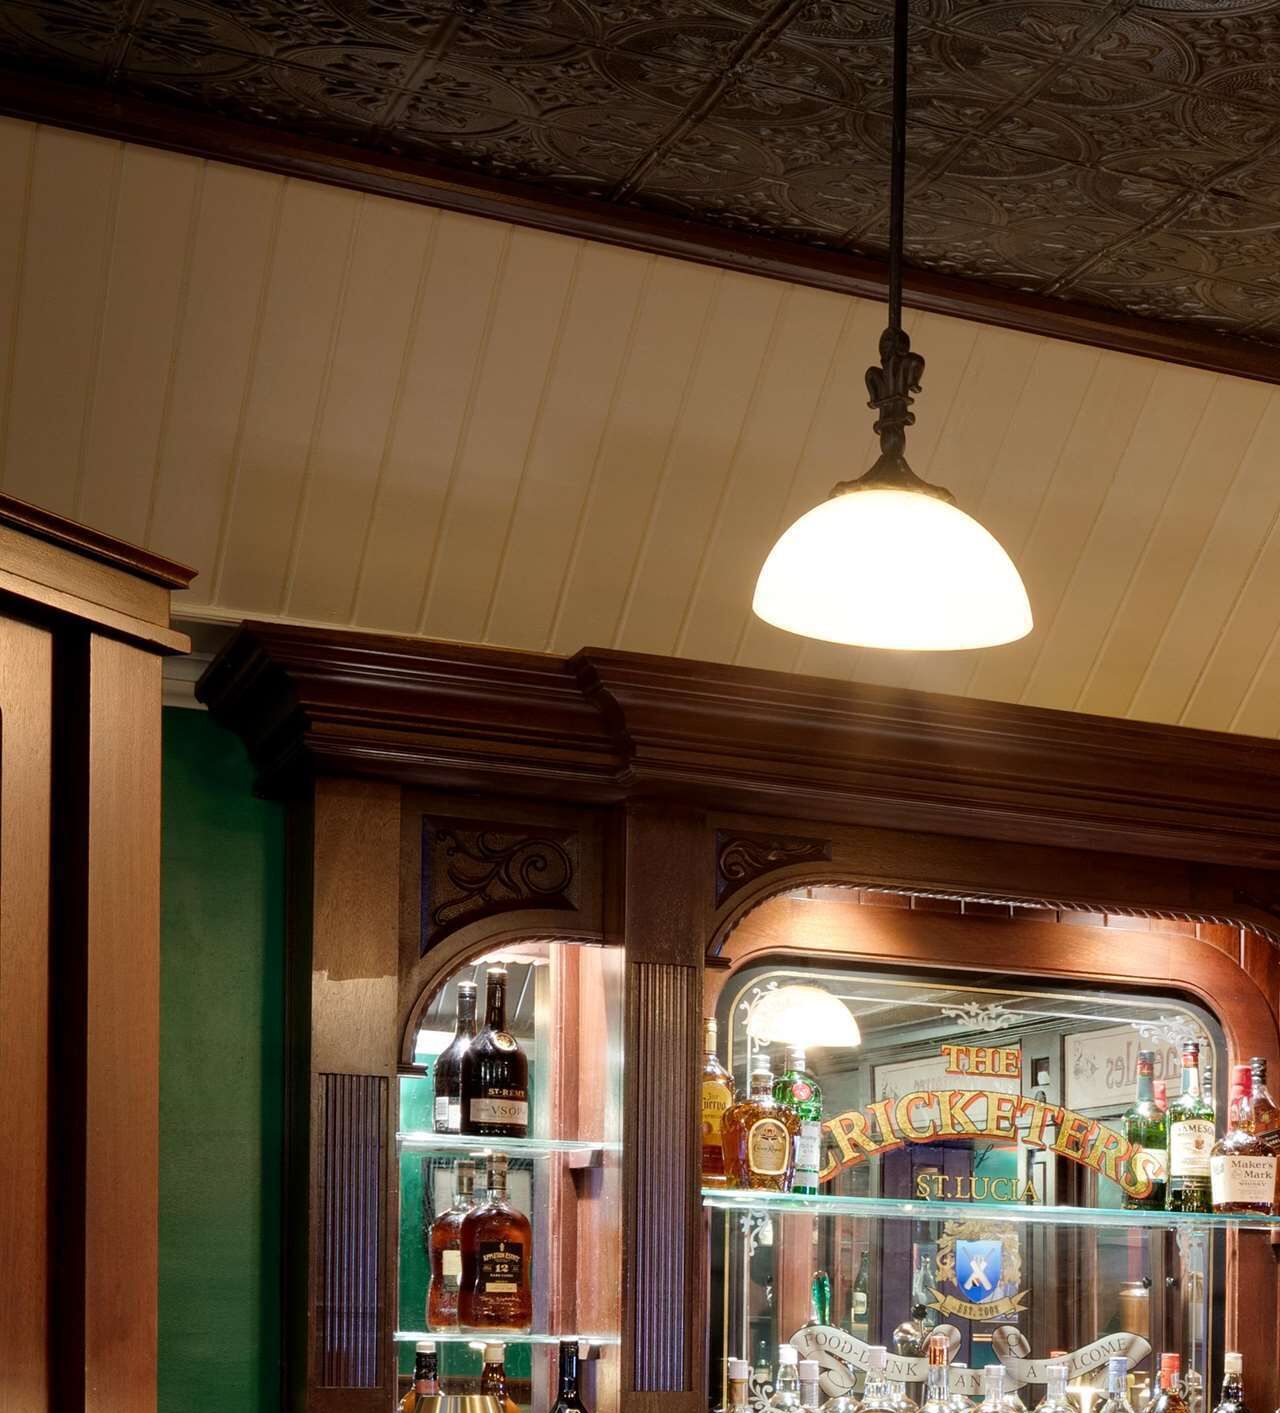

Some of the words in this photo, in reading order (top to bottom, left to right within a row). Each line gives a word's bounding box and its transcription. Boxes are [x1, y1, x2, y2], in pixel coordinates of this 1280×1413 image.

[941, 1044, 1022, 1079] THE
[1231, 1159, 1274, 1169] Maker's
[1243, 1169, 1273, 1180] Mark
[495, 1264, 509, 1272] 12
